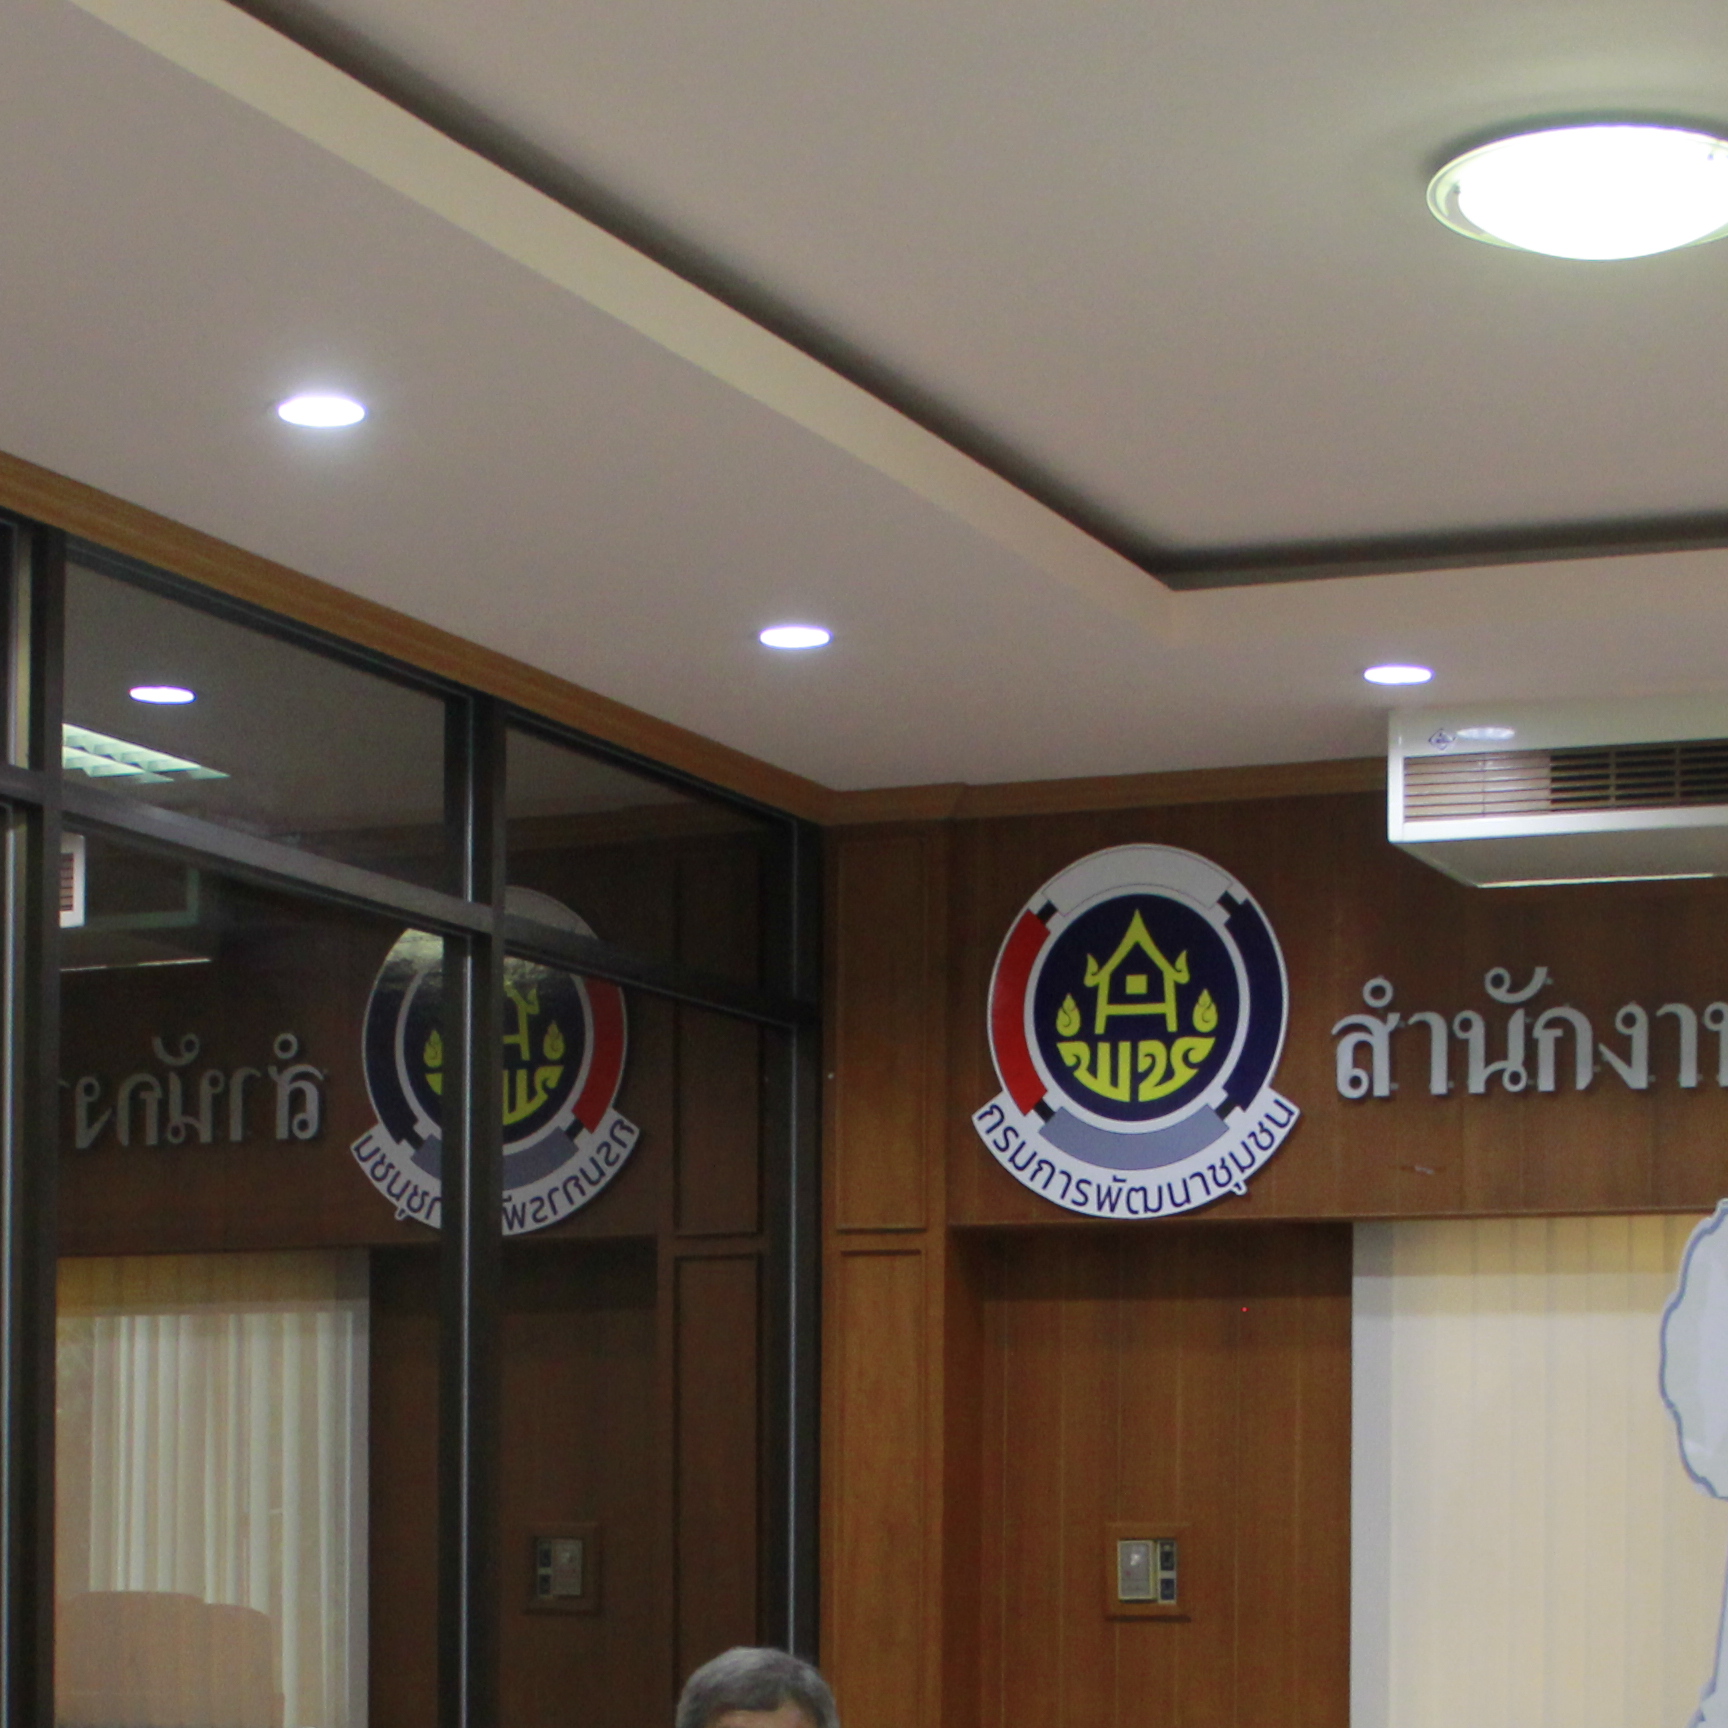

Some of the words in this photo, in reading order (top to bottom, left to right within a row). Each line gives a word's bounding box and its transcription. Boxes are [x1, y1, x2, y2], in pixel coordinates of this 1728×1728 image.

[977, 1097, 1295, 1215] กรมการพัฒนาชุมชน
